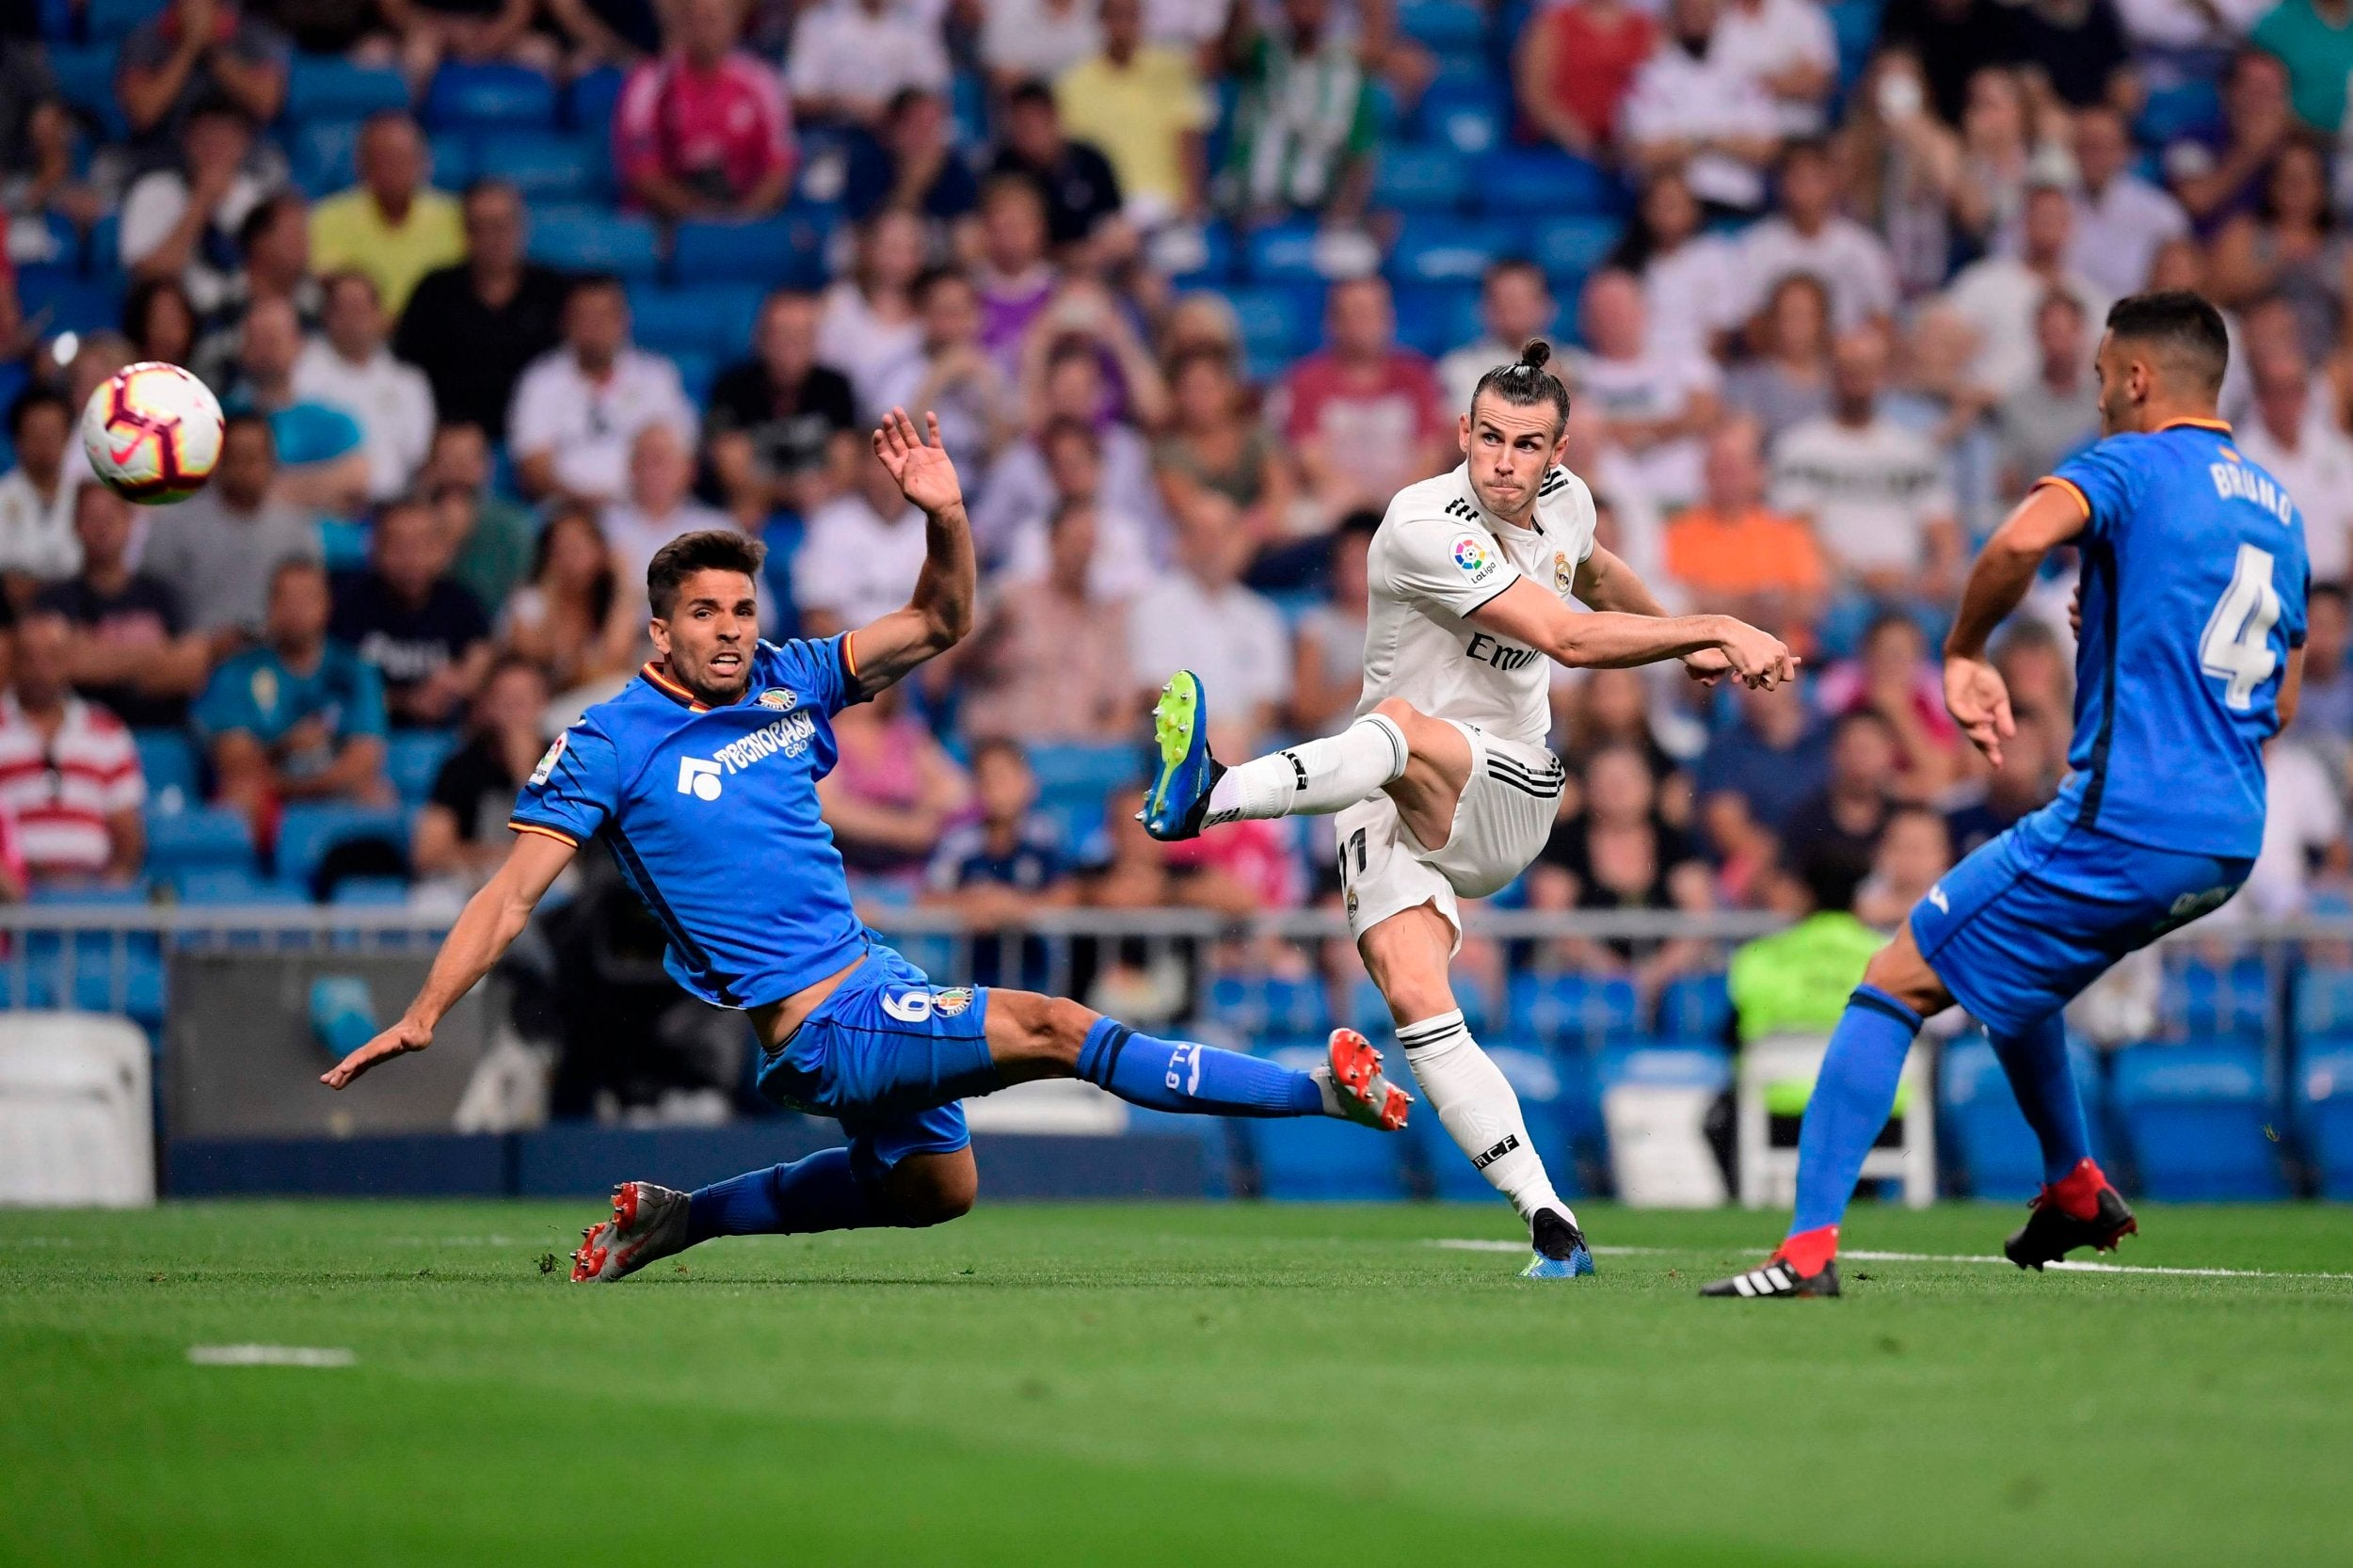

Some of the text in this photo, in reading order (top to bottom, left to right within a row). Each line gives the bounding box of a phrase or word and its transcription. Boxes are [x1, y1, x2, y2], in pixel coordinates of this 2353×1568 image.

[2209, 461, 2293, 527] BRUNO
[1471, 561, 1497, 584] LaLiga
[2198, 542, 2281, 710] 4
[712, 709, 816, 776] TECNOCASA
[1337, 826, 1368, 894] 11
